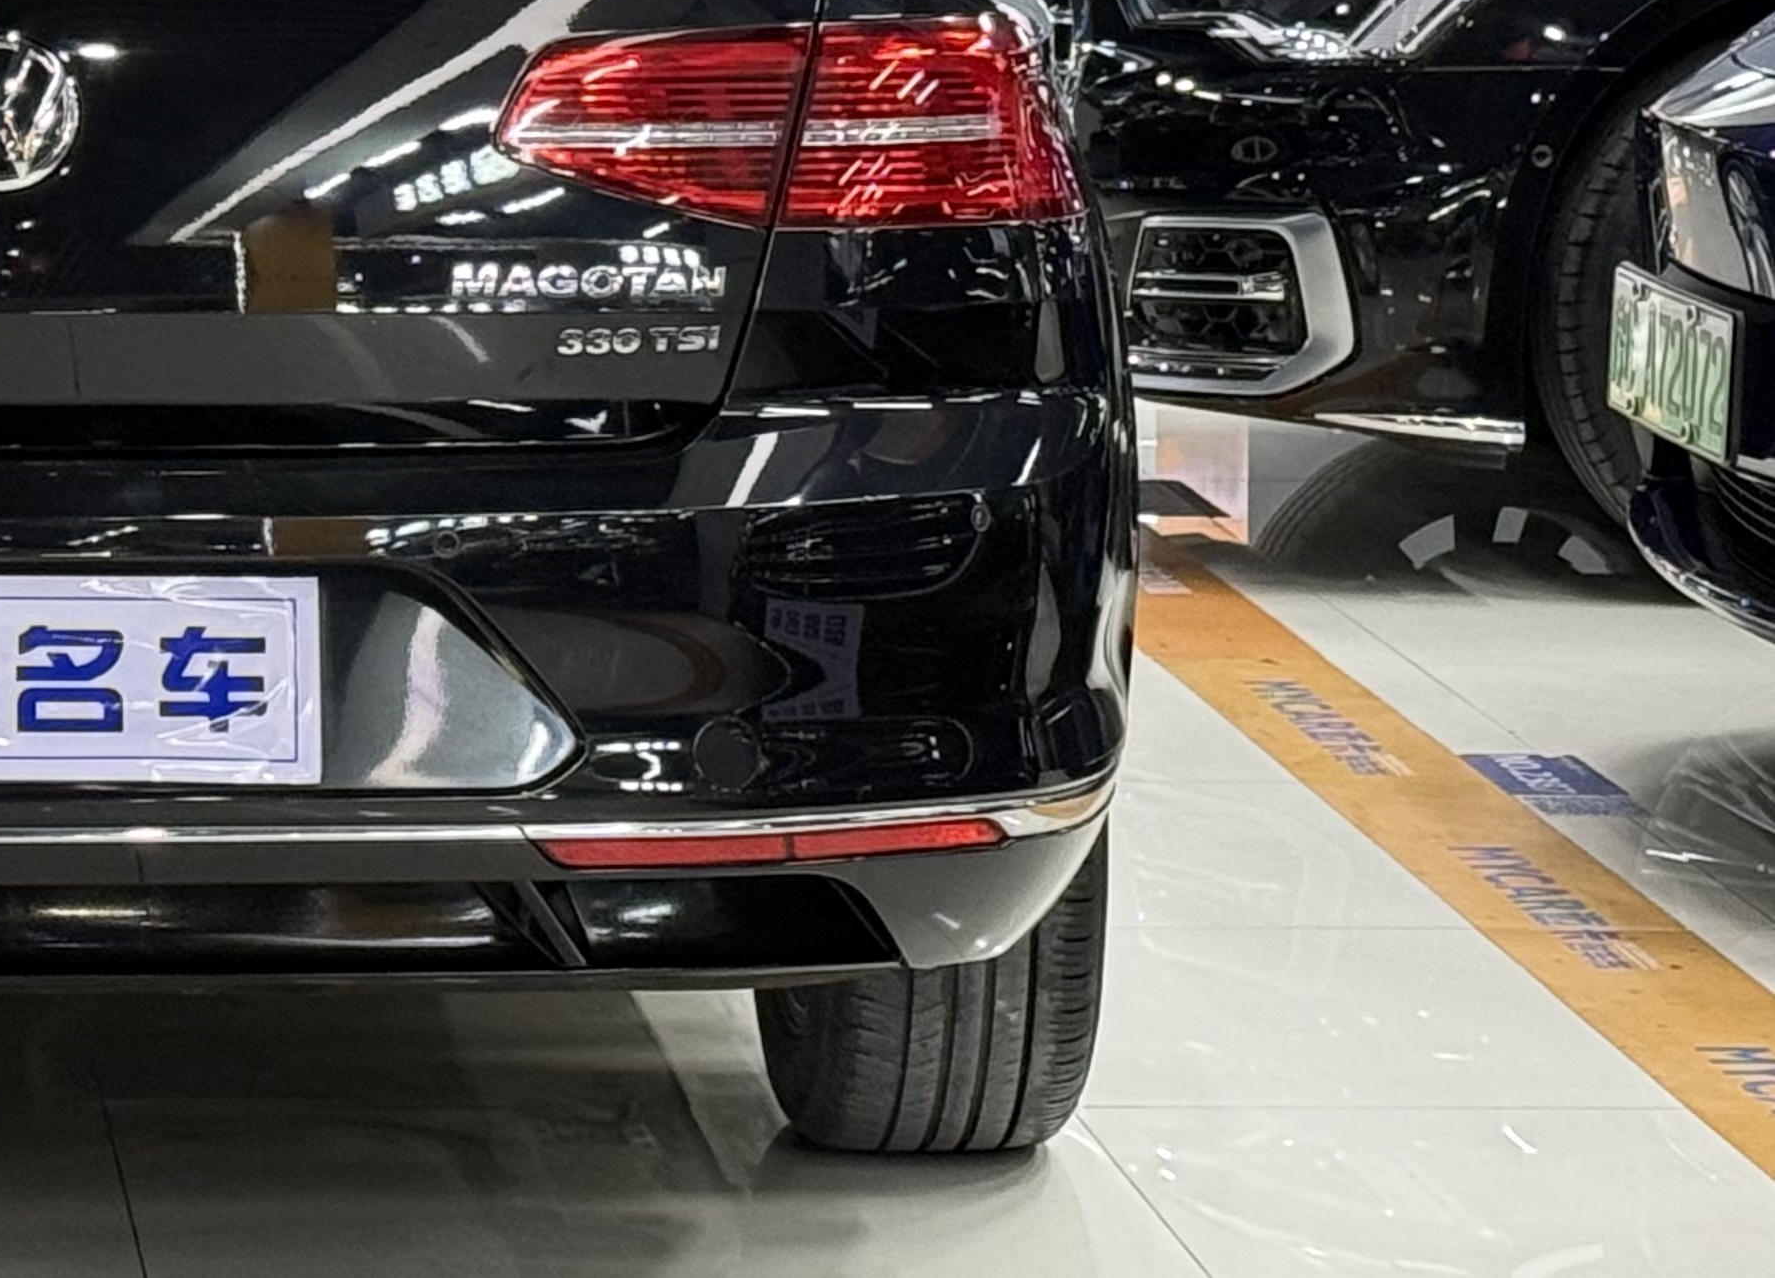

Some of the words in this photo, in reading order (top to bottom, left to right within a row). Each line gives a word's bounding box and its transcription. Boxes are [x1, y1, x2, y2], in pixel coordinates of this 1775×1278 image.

[451, 262, 727, 298] MAGOTAN
[557, 327, 642, 356] 330
[648, 325, 722, 353] TSI
